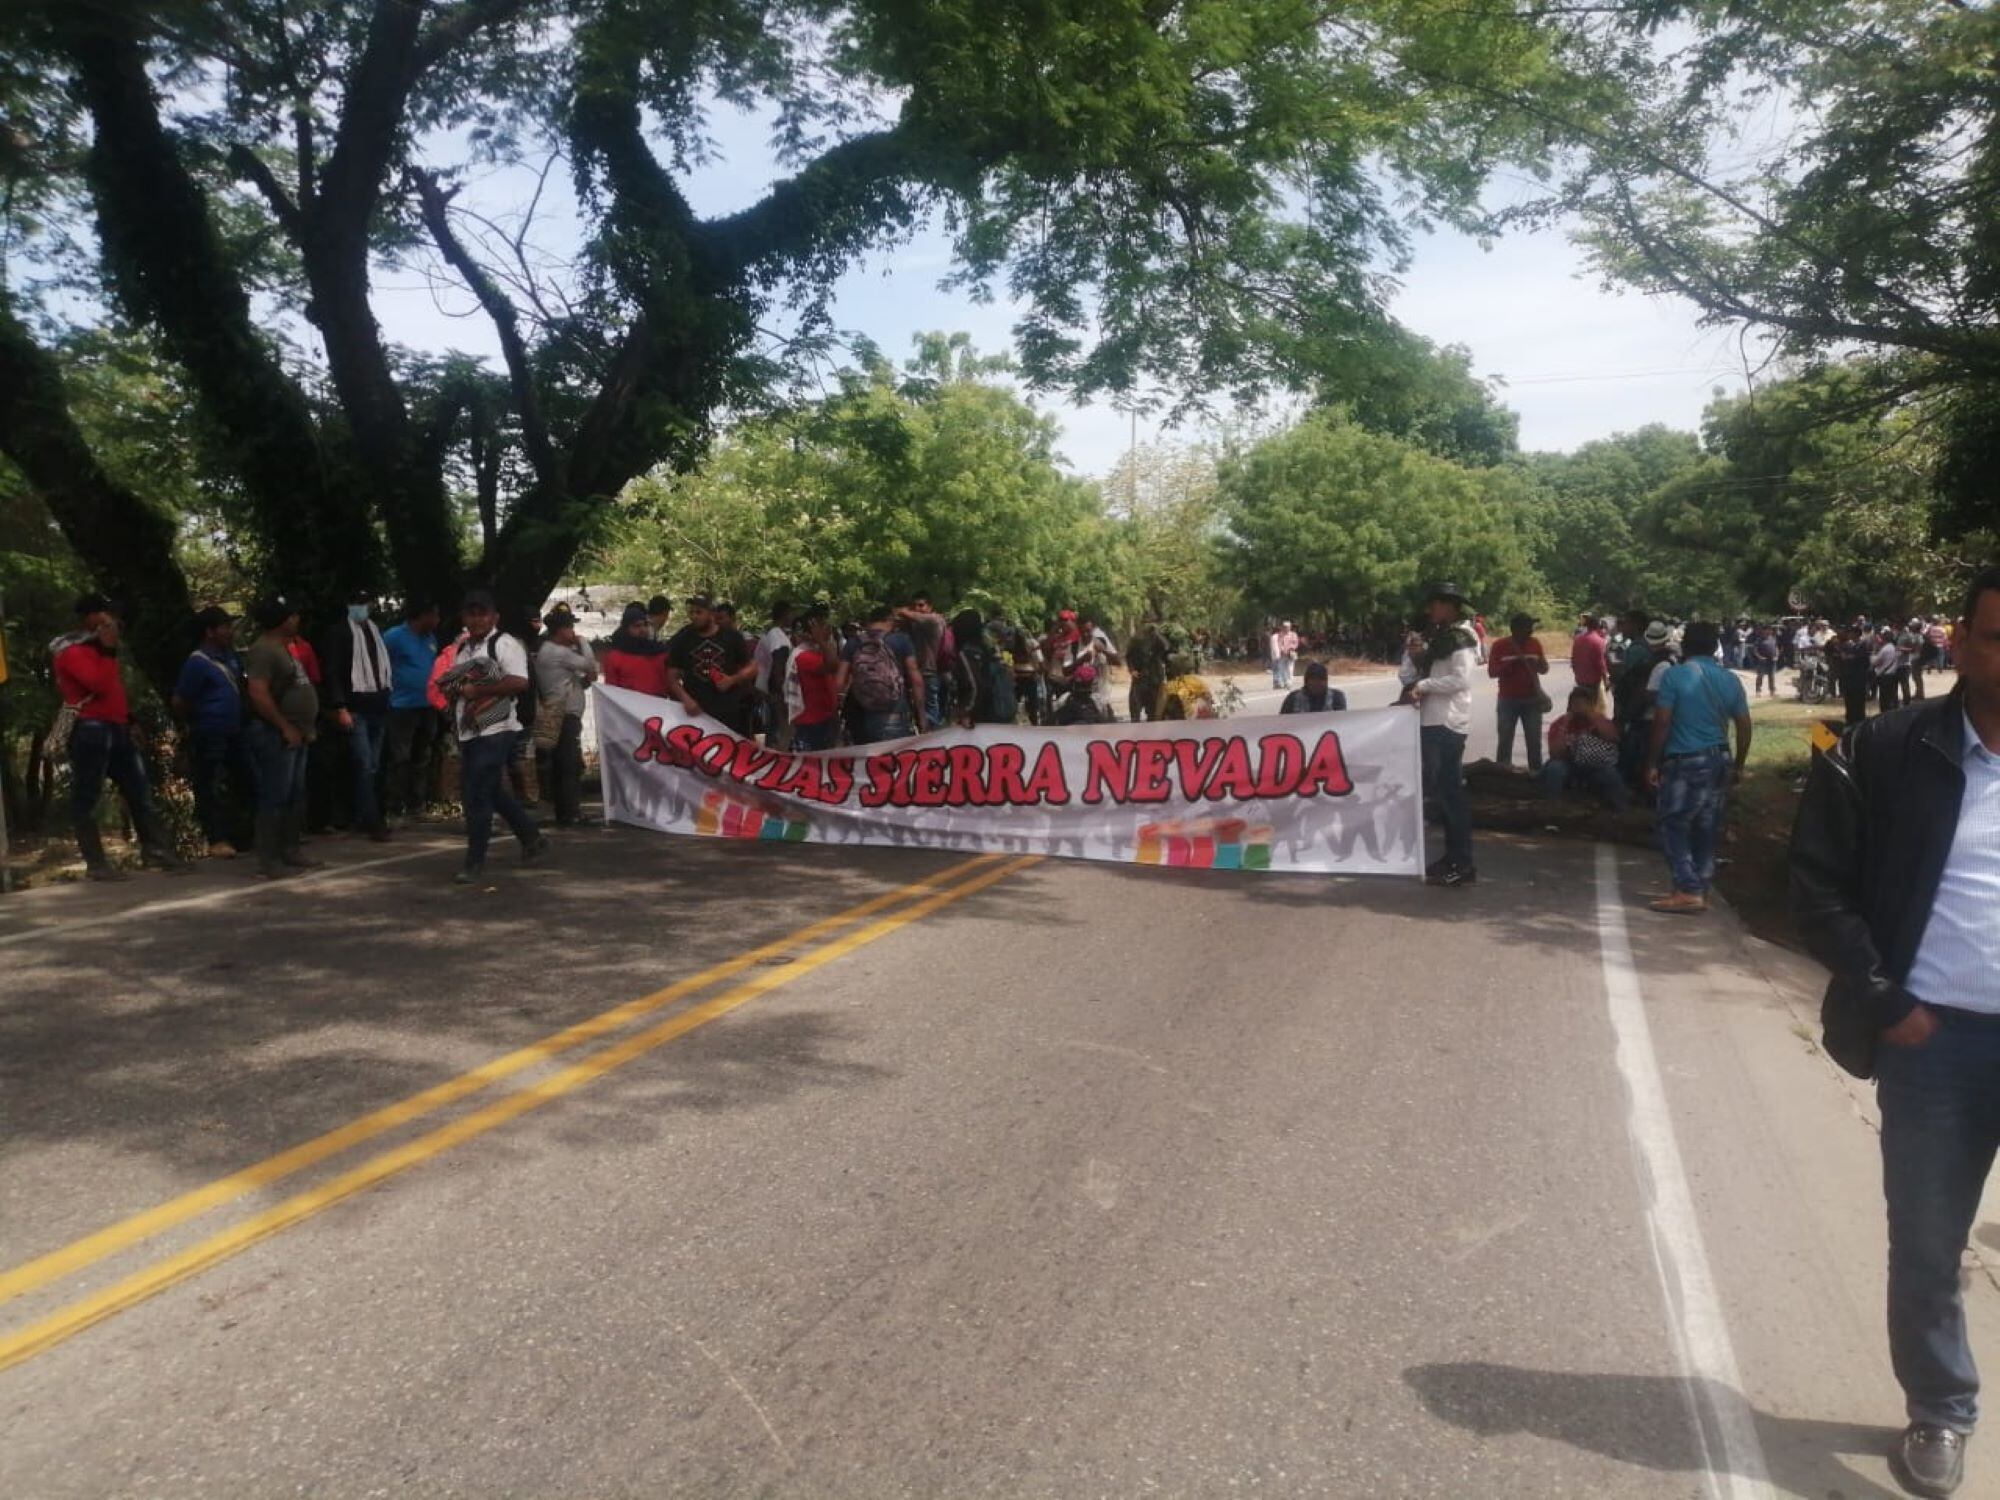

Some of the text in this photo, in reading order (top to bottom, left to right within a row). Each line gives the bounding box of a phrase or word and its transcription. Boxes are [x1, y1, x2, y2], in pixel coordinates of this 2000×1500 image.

[634, 716, 1354, 807] ASOVIAS SIERRA NEVADA
